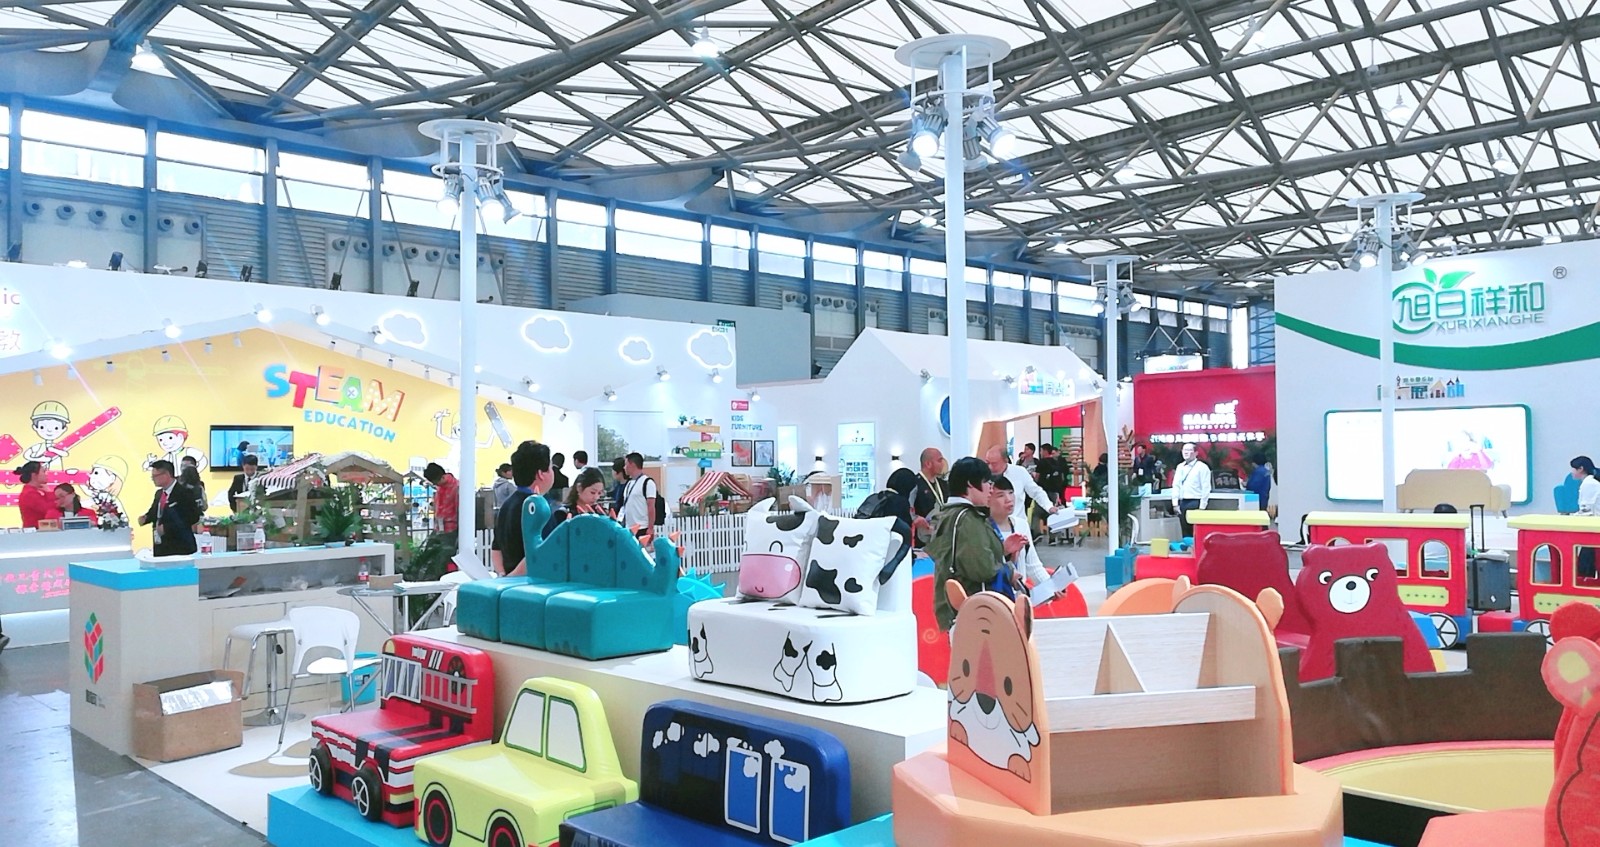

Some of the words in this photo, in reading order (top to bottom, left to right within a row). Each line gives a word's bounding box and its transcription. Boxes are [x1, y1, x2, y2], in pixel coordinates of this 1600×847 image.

[1398, 282, 1546, 324] 旭日祥和
[1436, 312, 1546, 333] XURIXIANGHE
[263, 363, 406, 422] STEAM
[303, 410, 397, 442] EDUCATION
